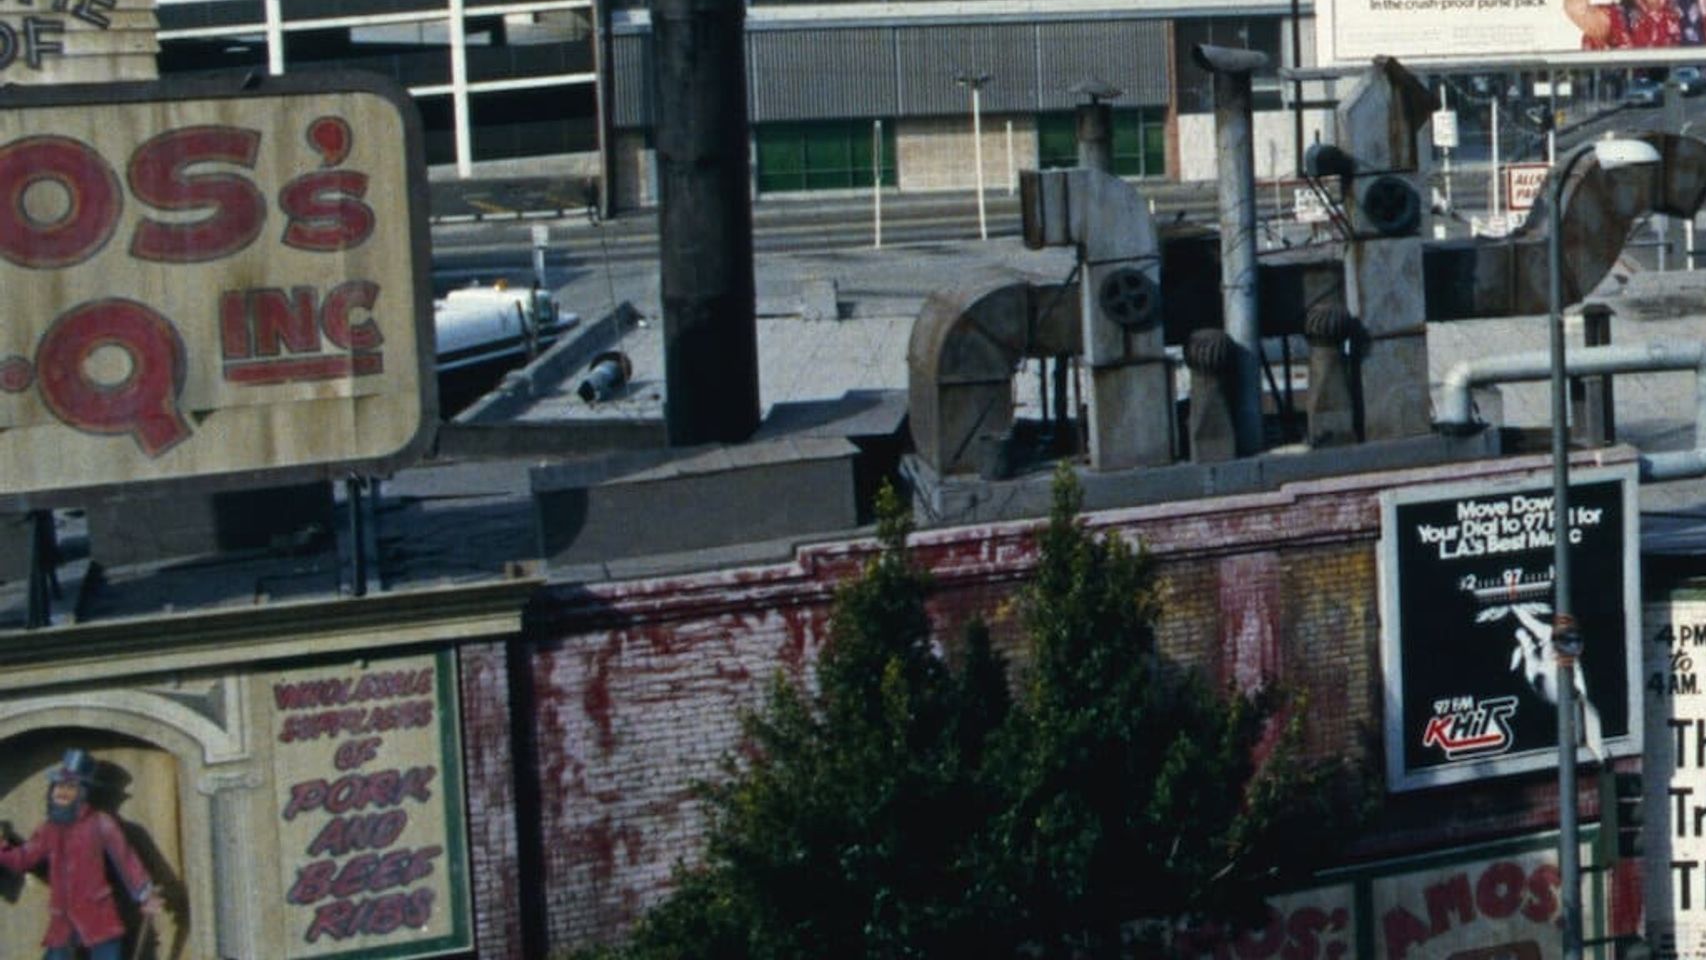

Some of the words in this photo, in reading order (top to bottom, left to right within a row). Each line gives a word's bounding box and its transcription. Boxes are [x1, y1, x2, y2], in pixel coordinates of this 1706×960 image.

[219, 280, 384, 360] INC
[1417, 524, 1459, 544] Your
[1463, 517, 1498, 538] Dial
[1502, 515, 1520, 534] to
[1523, 513, 1546, 531] 97
[1577, 506, 1602, 525] for
[1457, 500, 1509, 521] Move
[1512, 496, 1556, 514] Dow
[1487, 534, 1526, 553] Best
[1529, 529, 1583, 548] Muc
[1668, 649, 1692, 672] to
[334, 738, 383, 770] OF
[283, 766, 437, 822] PORK
[306, 810, 407, 858] AND
[286, 846, 443, 905] BEEF
[305, 887, 436, 943] RIBS
